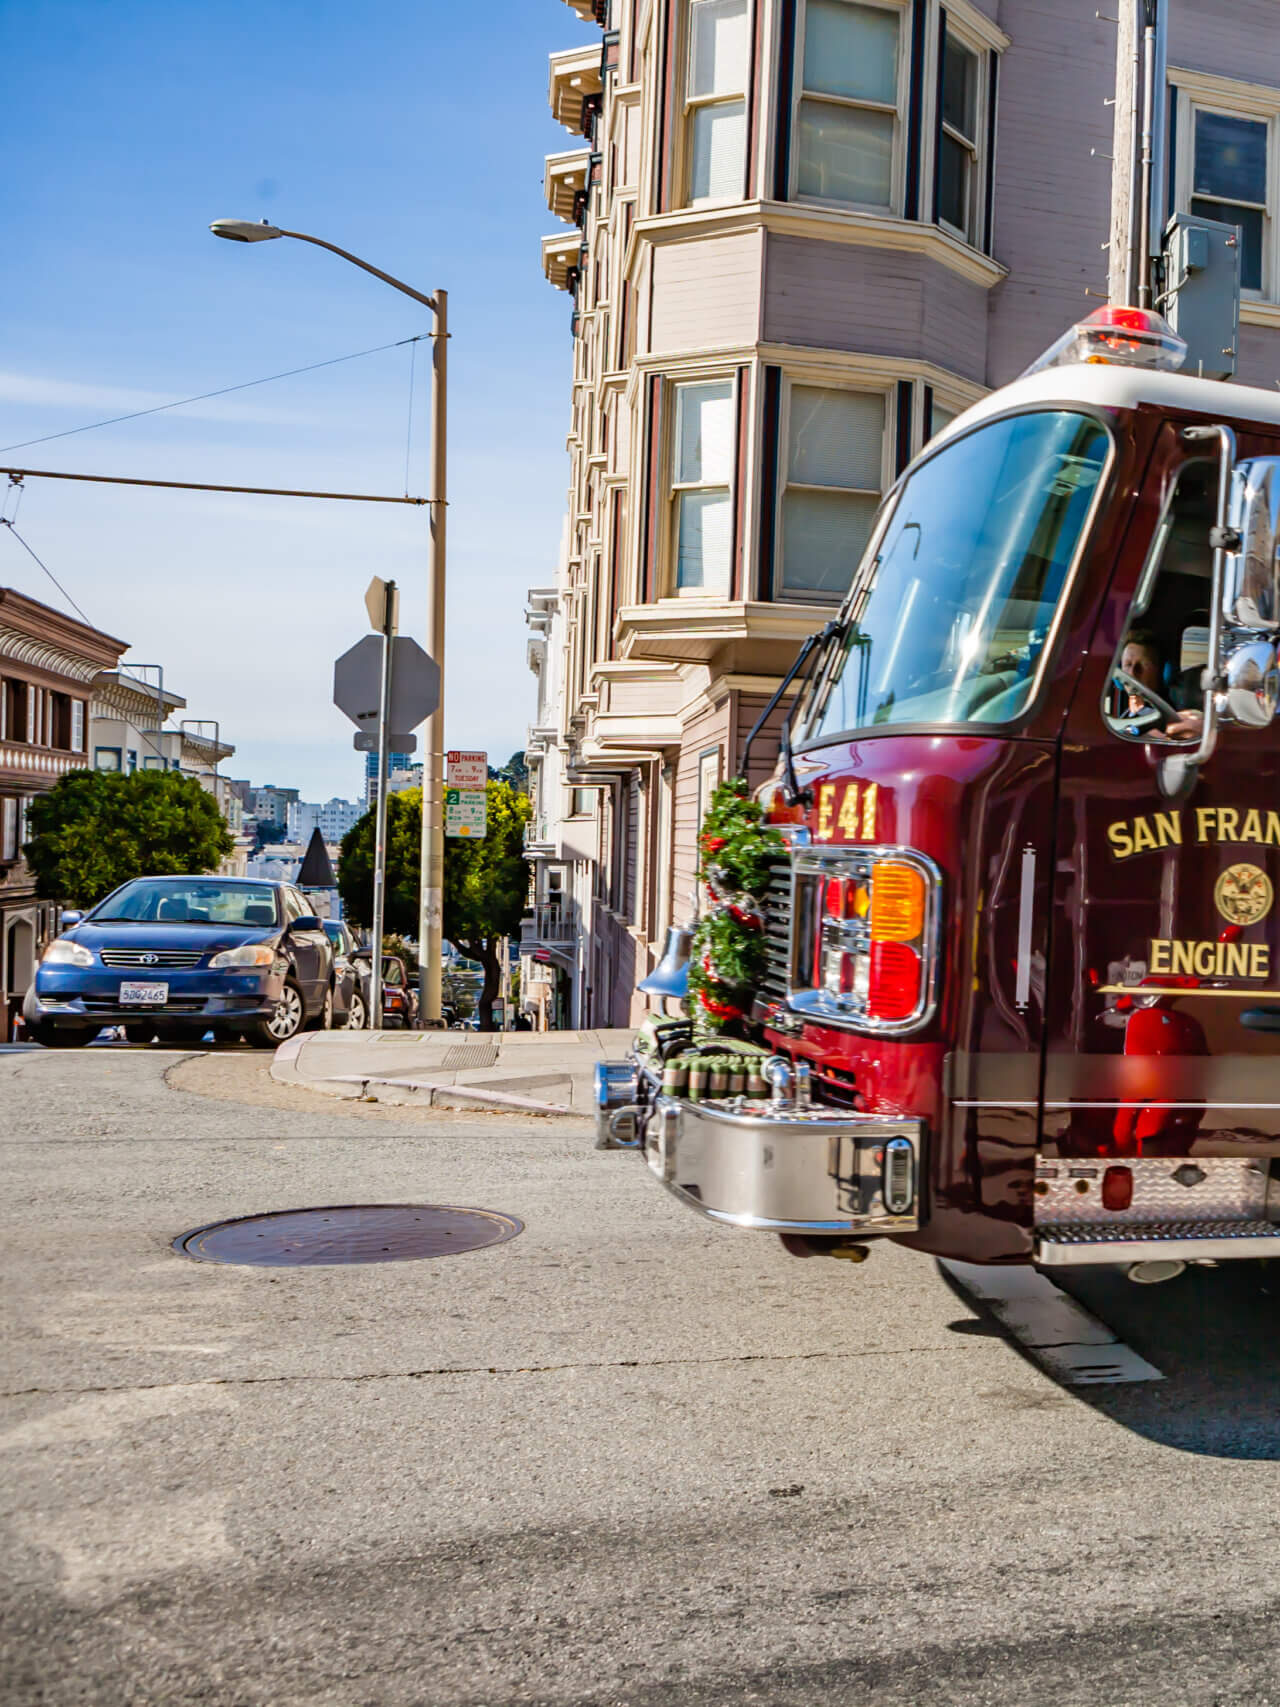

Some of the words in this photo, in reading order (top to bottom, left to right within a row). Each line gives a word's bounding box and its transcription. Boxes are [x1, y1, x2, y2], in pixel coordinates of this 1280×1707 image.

[448, 752, 459, 762] NO
[461, 754, 485, 763] PARKING
[449, 793, 457, 804] 2
[817, 782, 878, 840] E41
[1106, 810, 1183, 859] SAN
[1149, 938, 1270, 978] ENGINE
